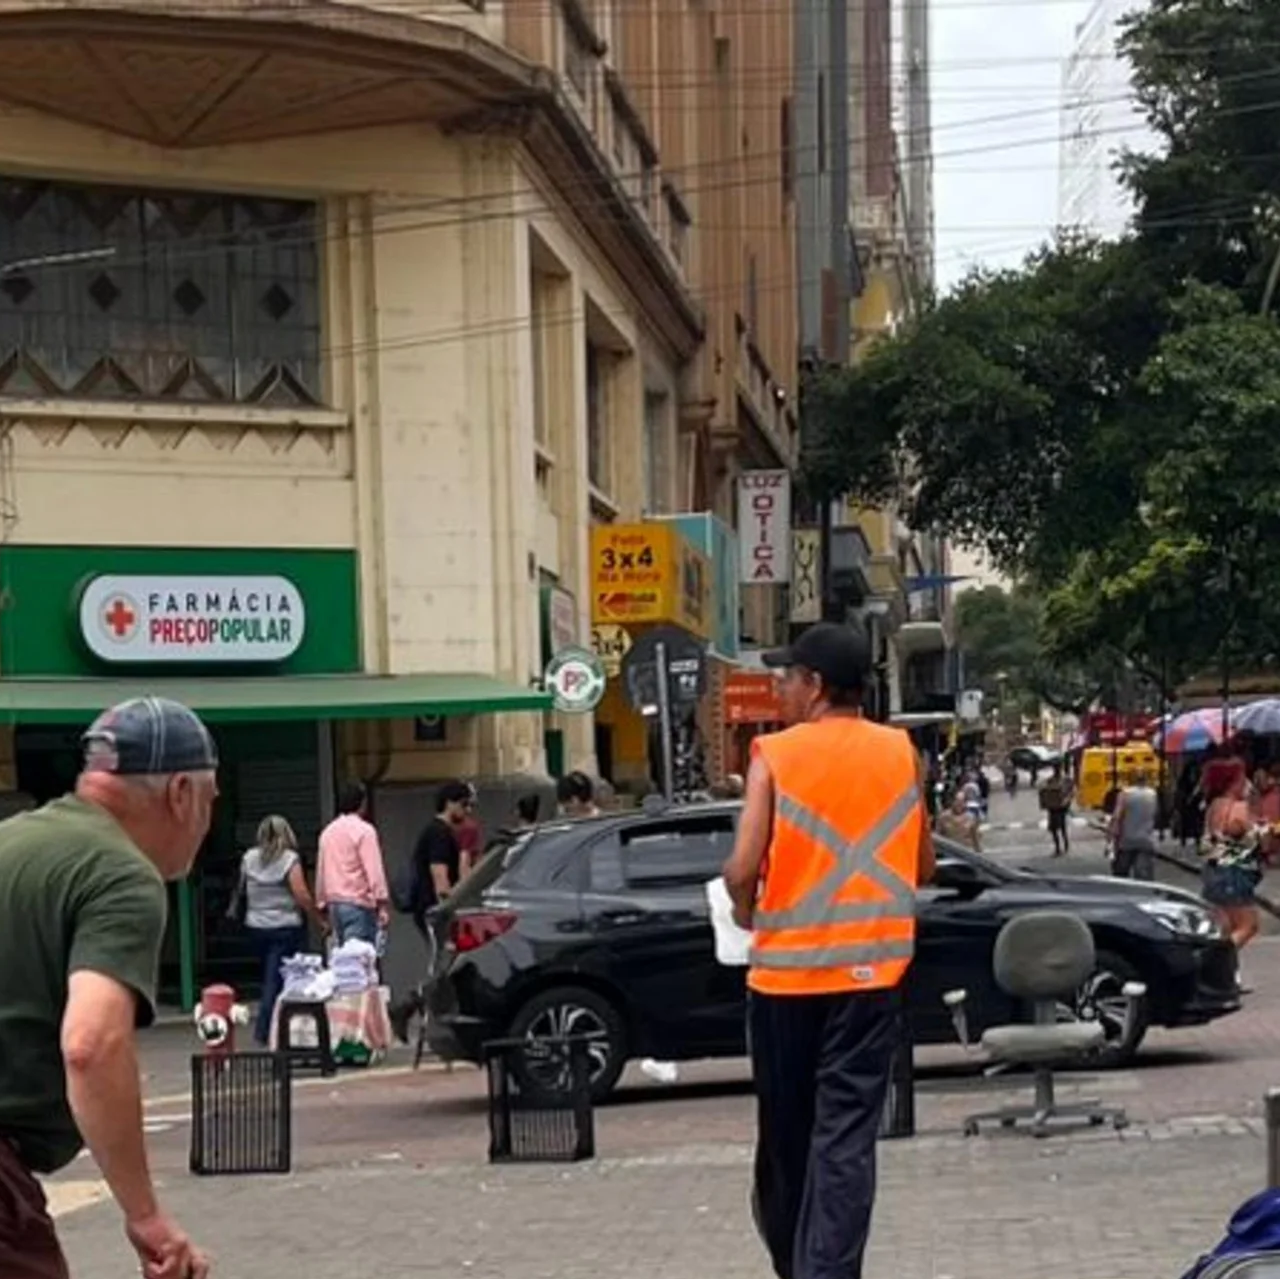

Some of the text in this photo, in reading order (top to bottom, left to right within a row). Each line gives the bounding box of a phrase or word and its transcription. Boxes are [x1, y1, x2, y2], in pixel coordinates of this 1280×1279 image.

[753, 495, 773, 578] OTICA
[600, 545, 653, 569] 3x4
[148, 588, 291, 612] FARMÁCIA
